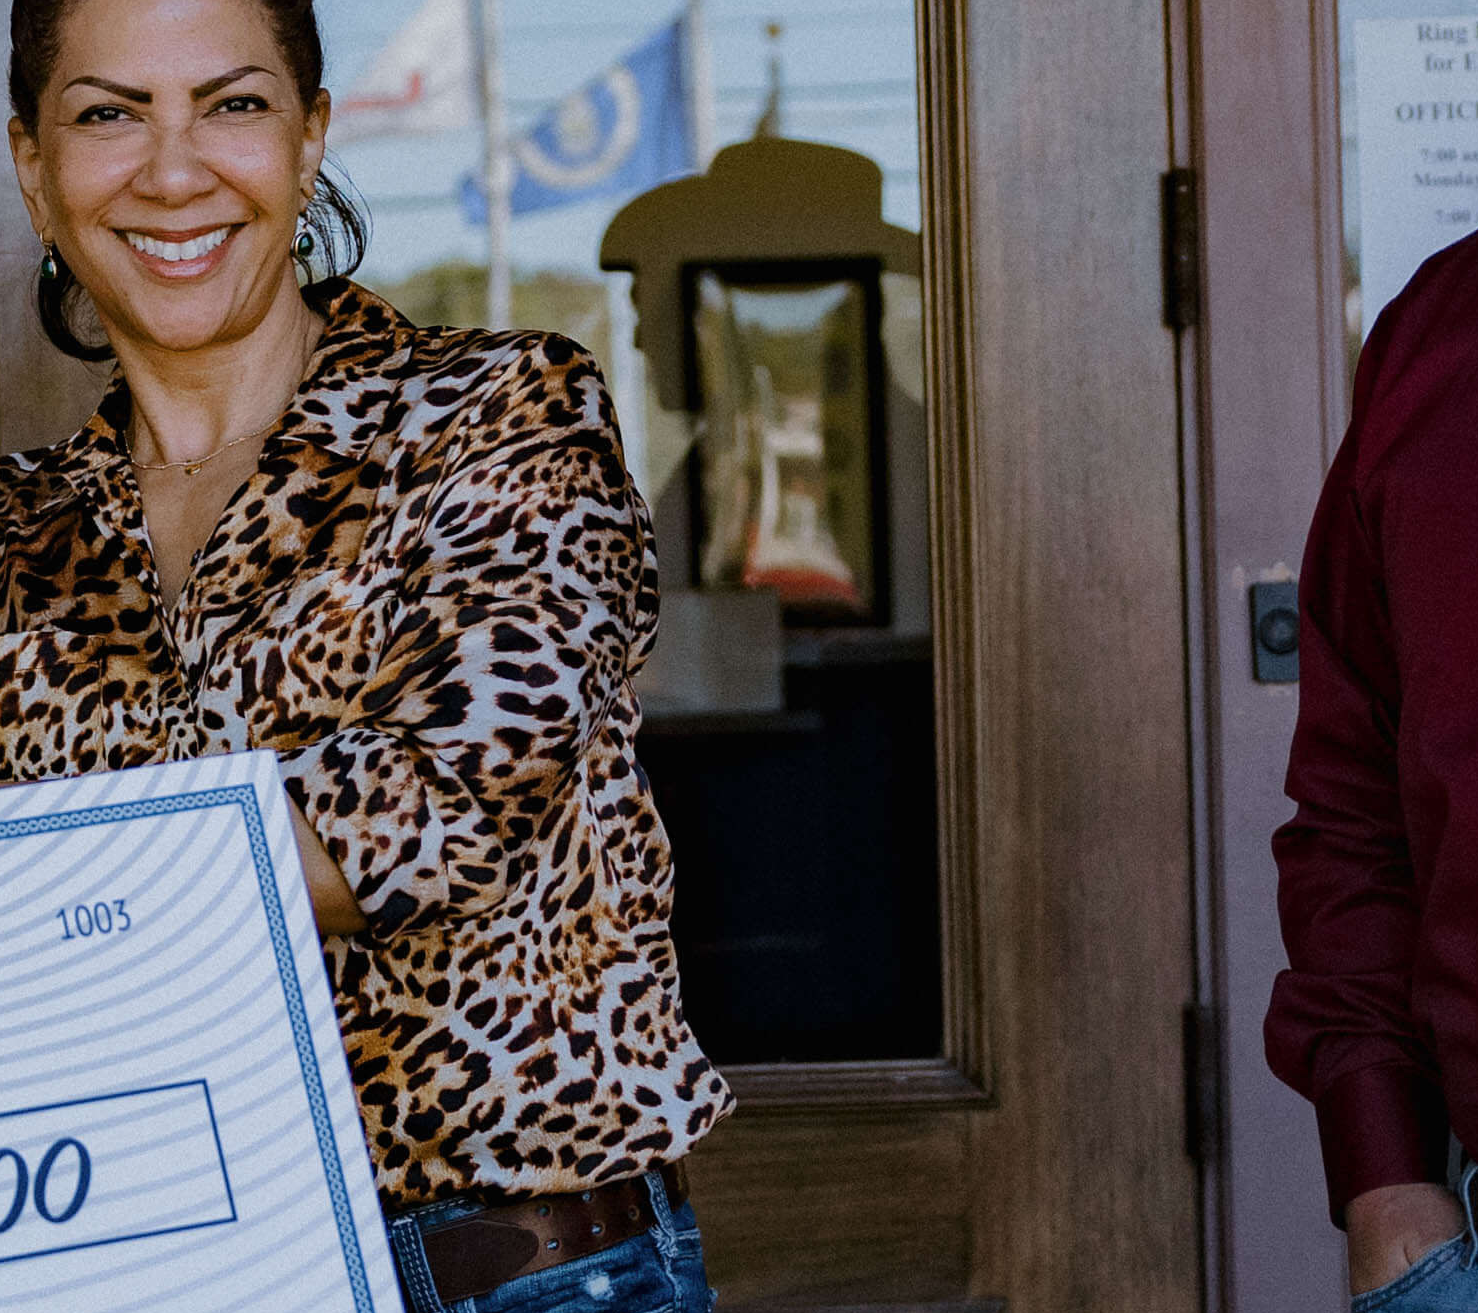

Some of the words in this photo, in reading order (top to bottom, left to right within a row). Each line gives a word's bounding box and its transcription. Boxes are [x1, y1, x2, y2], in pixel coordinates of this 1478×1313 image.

[1417, 22, 1468, 45] Ring
[1424, 53, 1454, 72] for
[53, 897, 133, 942] 1003
